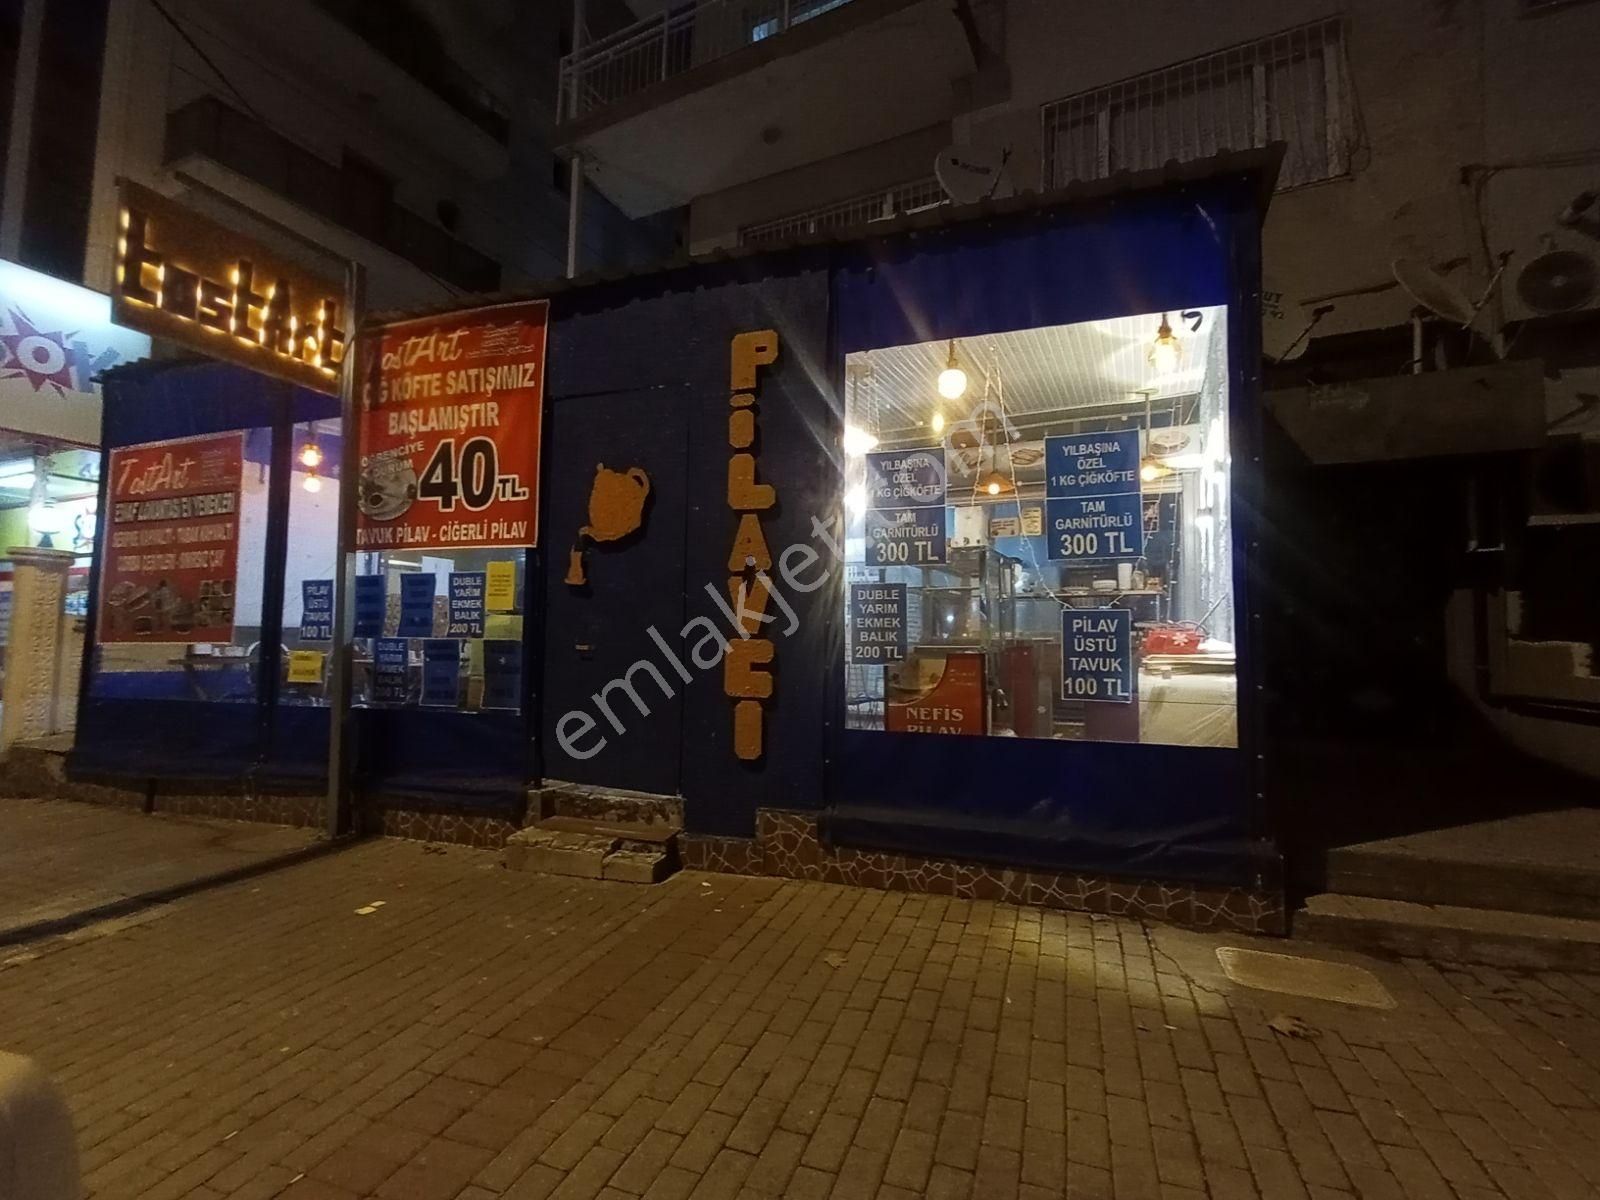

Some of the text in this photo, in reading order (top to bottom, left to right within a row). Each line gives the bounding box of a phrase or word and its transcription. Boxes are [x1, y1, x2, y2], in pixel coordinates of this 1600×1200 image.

[391, 370, 442, 402] KÖFTE
[445, 362, 536, 398] SATIŞIMIZ
[388, 401, 500, 440] BAŞLAMIŞTIR
[1062, 441, 1121, 457] YILBAŞINA
[1077, 457, 1107, 470] ÖZEL
[892, 472, 918, 483] ÖZEL
[1051, 469, 1135, 487] 1 KG ÇİĞKÖFTE
[877, 488, 892, 498] KG
[1081, 501, 1106, 513] TAM
[895, 512, 916, 523] TAM
[1055, 512, 1133, 530] GARNİTÜRLÜ
[396, 522, 431, 543] PİLAV
[490, 518, 528, 539] PİLAV
[724, 330, 778, 760] PİLAVCI
[1060, 531, 1135, 556] 300 TL
[877, 541, 939, 562] 300 TL
[453, 576, 482, 586] DUBLE
[858, 589, 900, 601] DUBLE
[451, 599, 482, 609] EKMEK
[859, 603, 898, 614] YARIM
[454, 611, 481, 620] BALIK
[856, 617, 901, 628] EKMEK
[450, 623, 483, 634] 200 TL
[1072, 616, 1119, 633] PİLAV
[860, 631, 898, 642] BALIK
[1074, 635, 1117, 652] ÜSTÜ
[855, 646, 904, 659] 200 TL
[1069, 657, 1122, 672] TAVUK
[1064, 678, 1129, 696] 100 TL
[905, 704, 965, 722] NEFİS
